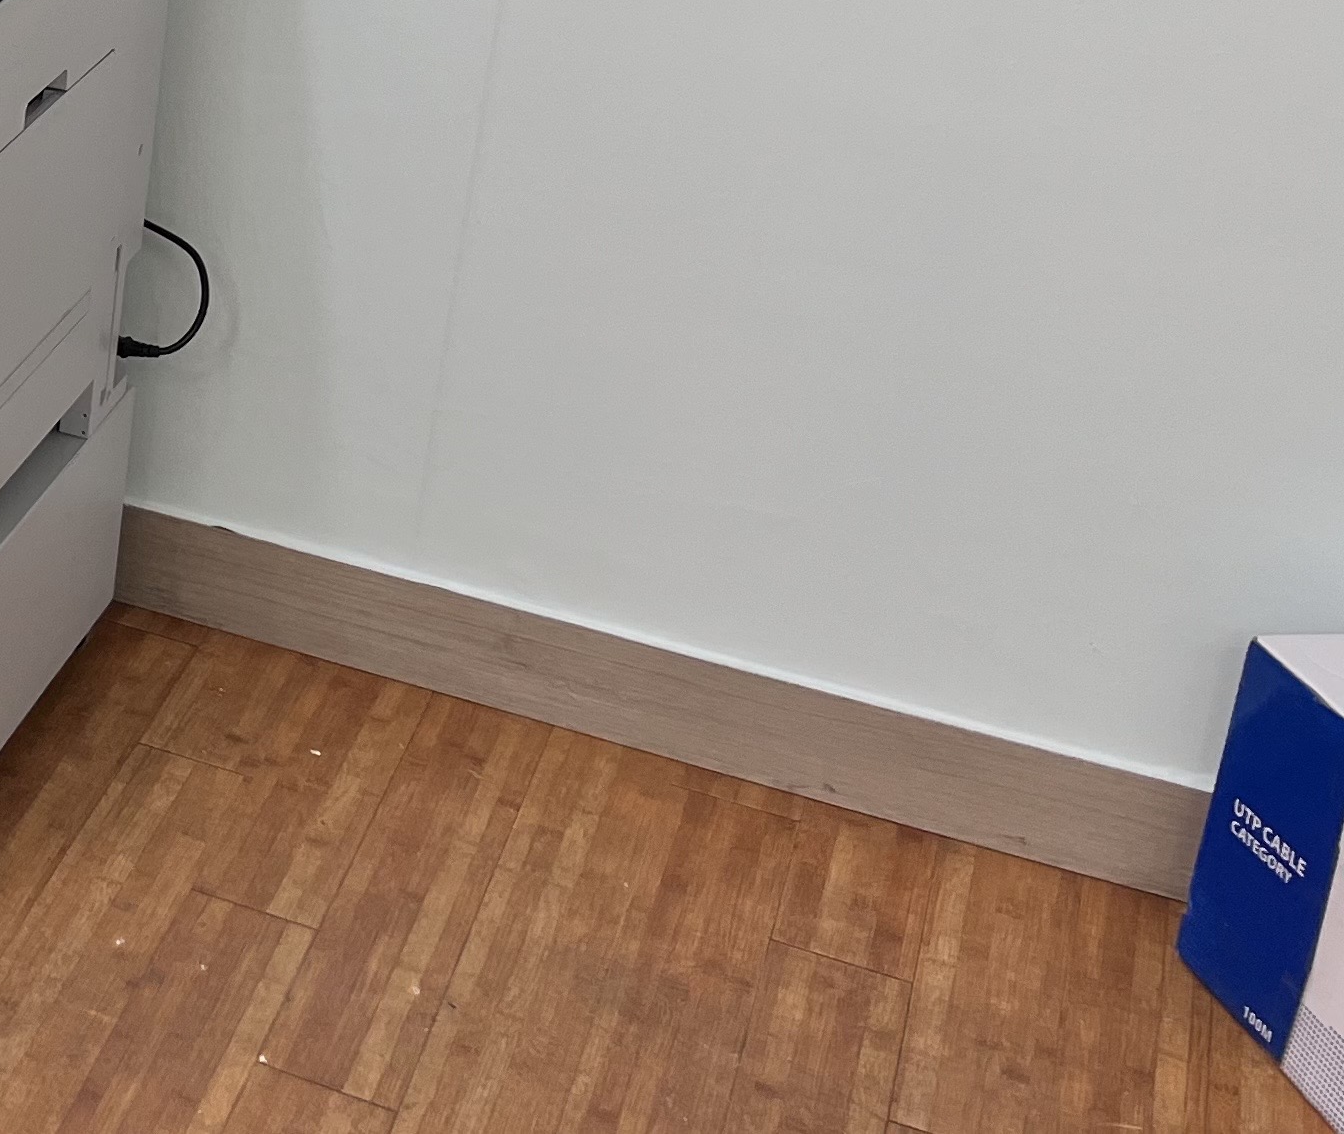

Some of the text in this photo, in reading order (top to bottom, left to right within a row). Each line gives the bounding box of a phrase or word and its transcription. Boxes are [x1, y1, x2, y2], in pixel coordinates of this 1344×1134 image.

[1231, 820, 1293, 883] CATEGORY
[1234, 798, 1307, 877] UTP CABLE
[1243, 1005, 1273, 1043] 100M
